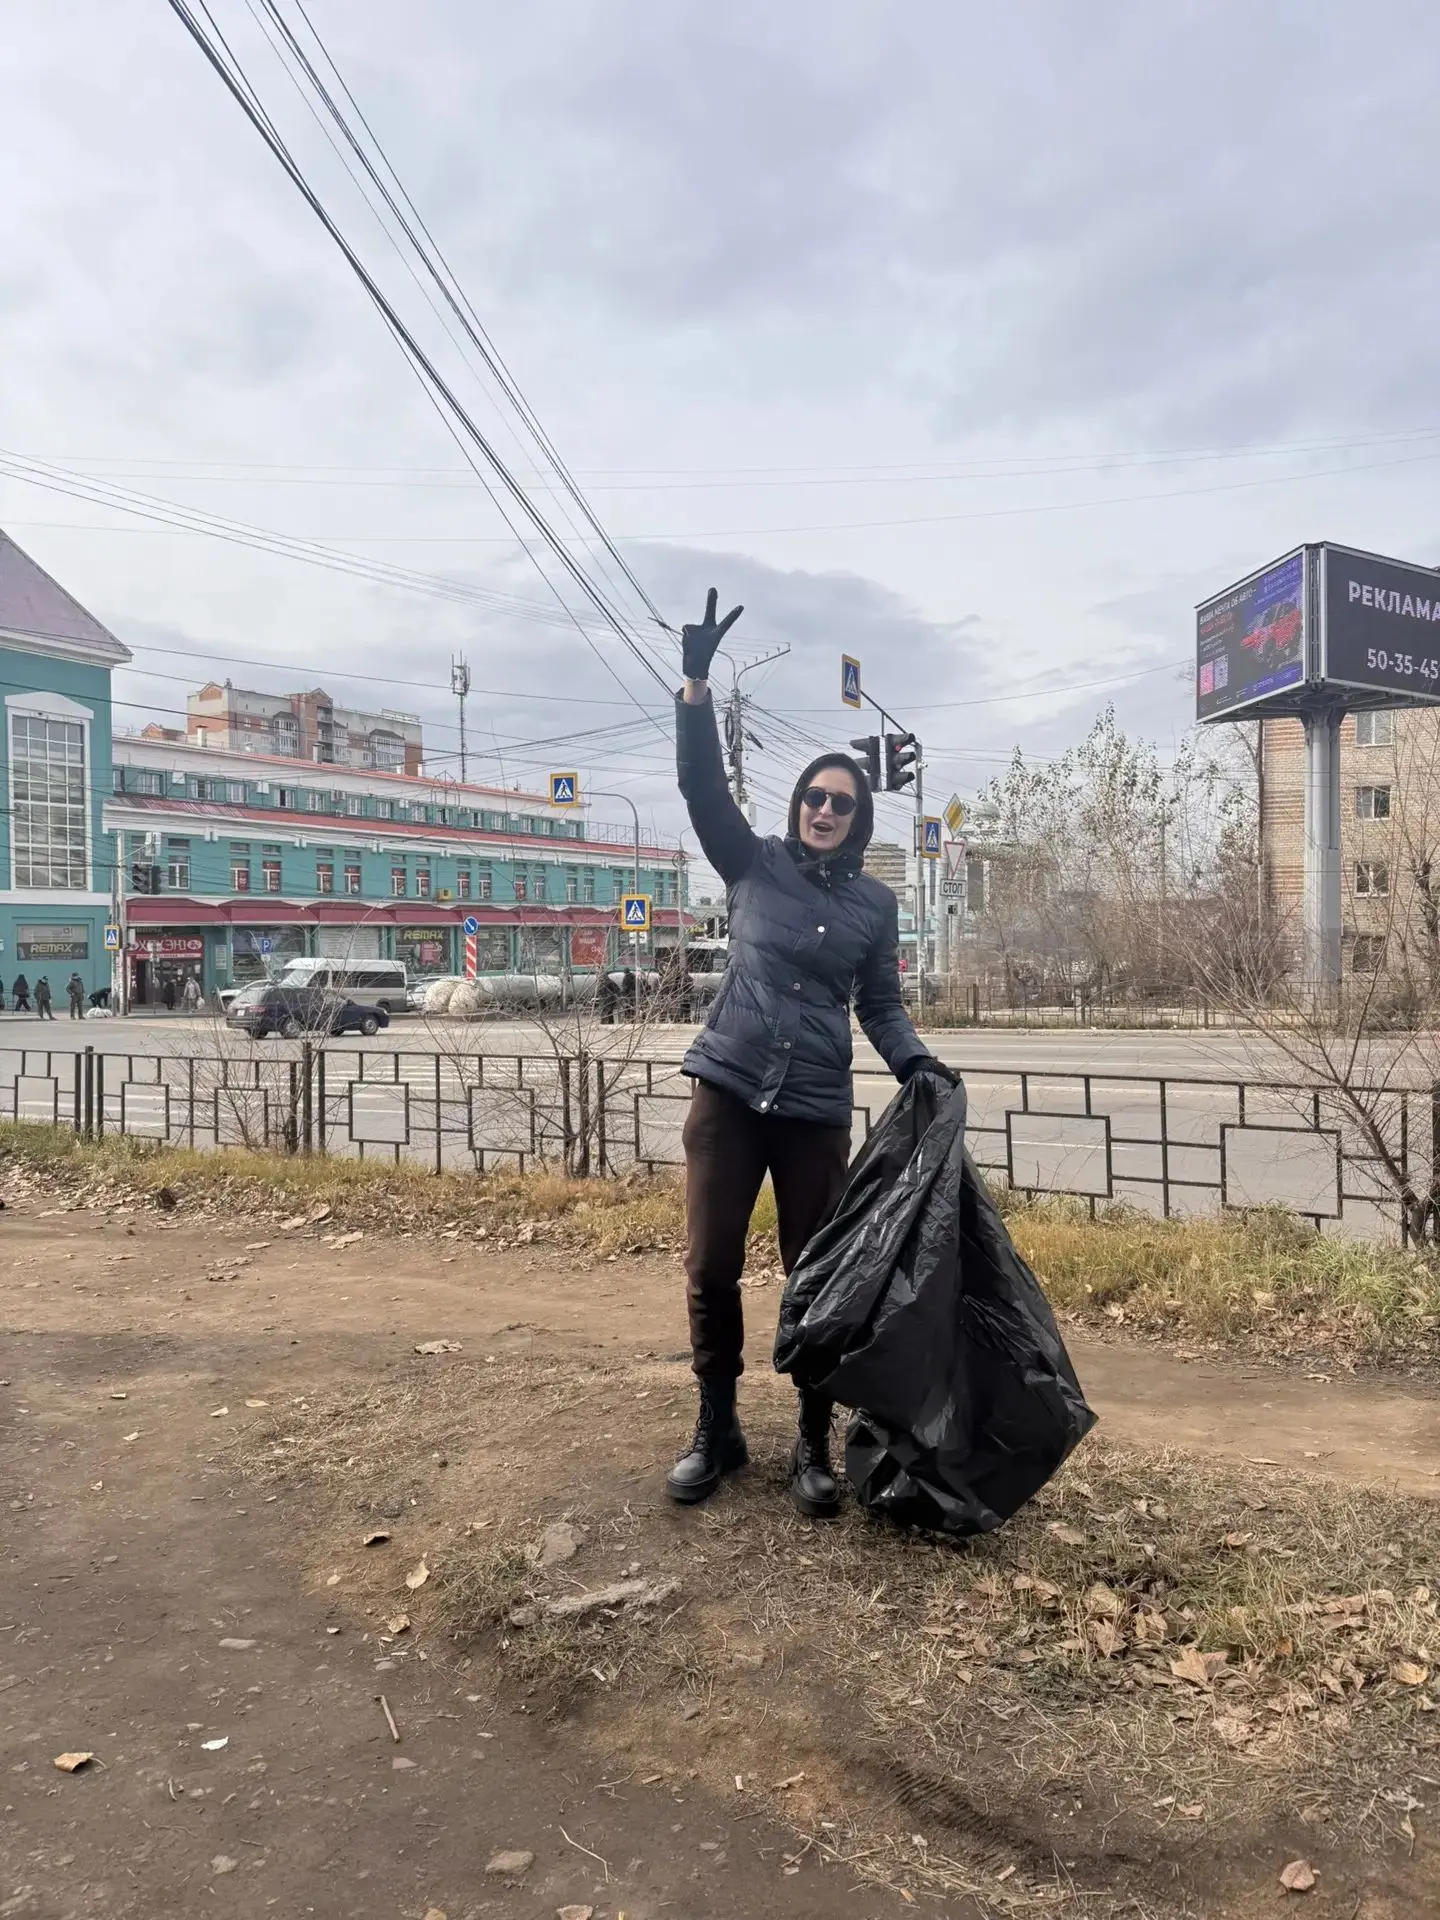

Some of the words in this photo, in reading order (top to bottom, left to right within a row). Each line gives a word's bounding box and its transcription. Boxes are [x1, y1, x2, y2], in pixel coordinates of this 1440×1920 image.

[1348, 580, 1440, 621] РЕКЛАМА
[1366, 648, 1439, 679] 50-35-45
[943, 882, 963, 894] СТОП
[403, 930, 444, 940] REMAX
[30, 943, 73, 953] REMAX
